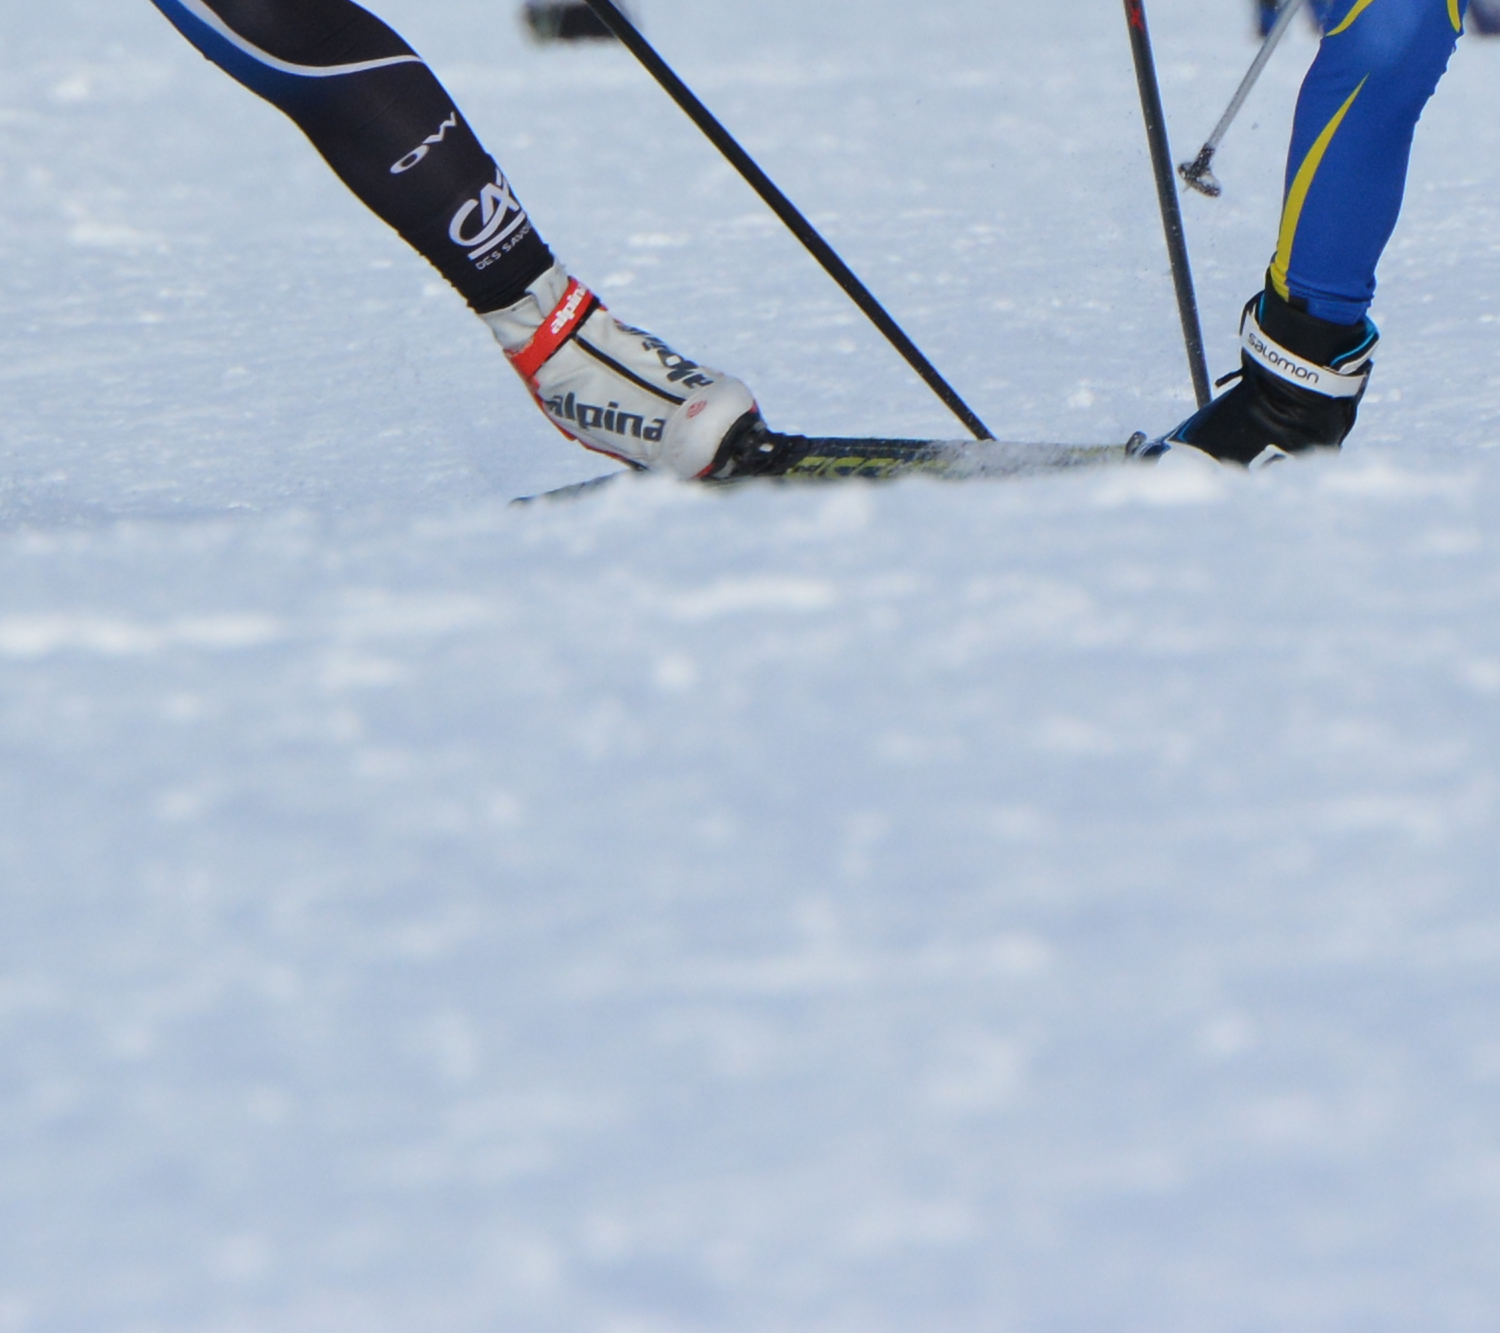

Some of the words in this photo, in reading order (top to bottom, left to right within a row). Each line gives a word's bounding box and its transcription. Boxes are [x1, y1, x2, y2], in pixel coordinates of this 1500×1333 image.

[389, 111, 457, 175] OW
[475, 251, 503, 271] DES
[543, 391, 667, 442] alpina
